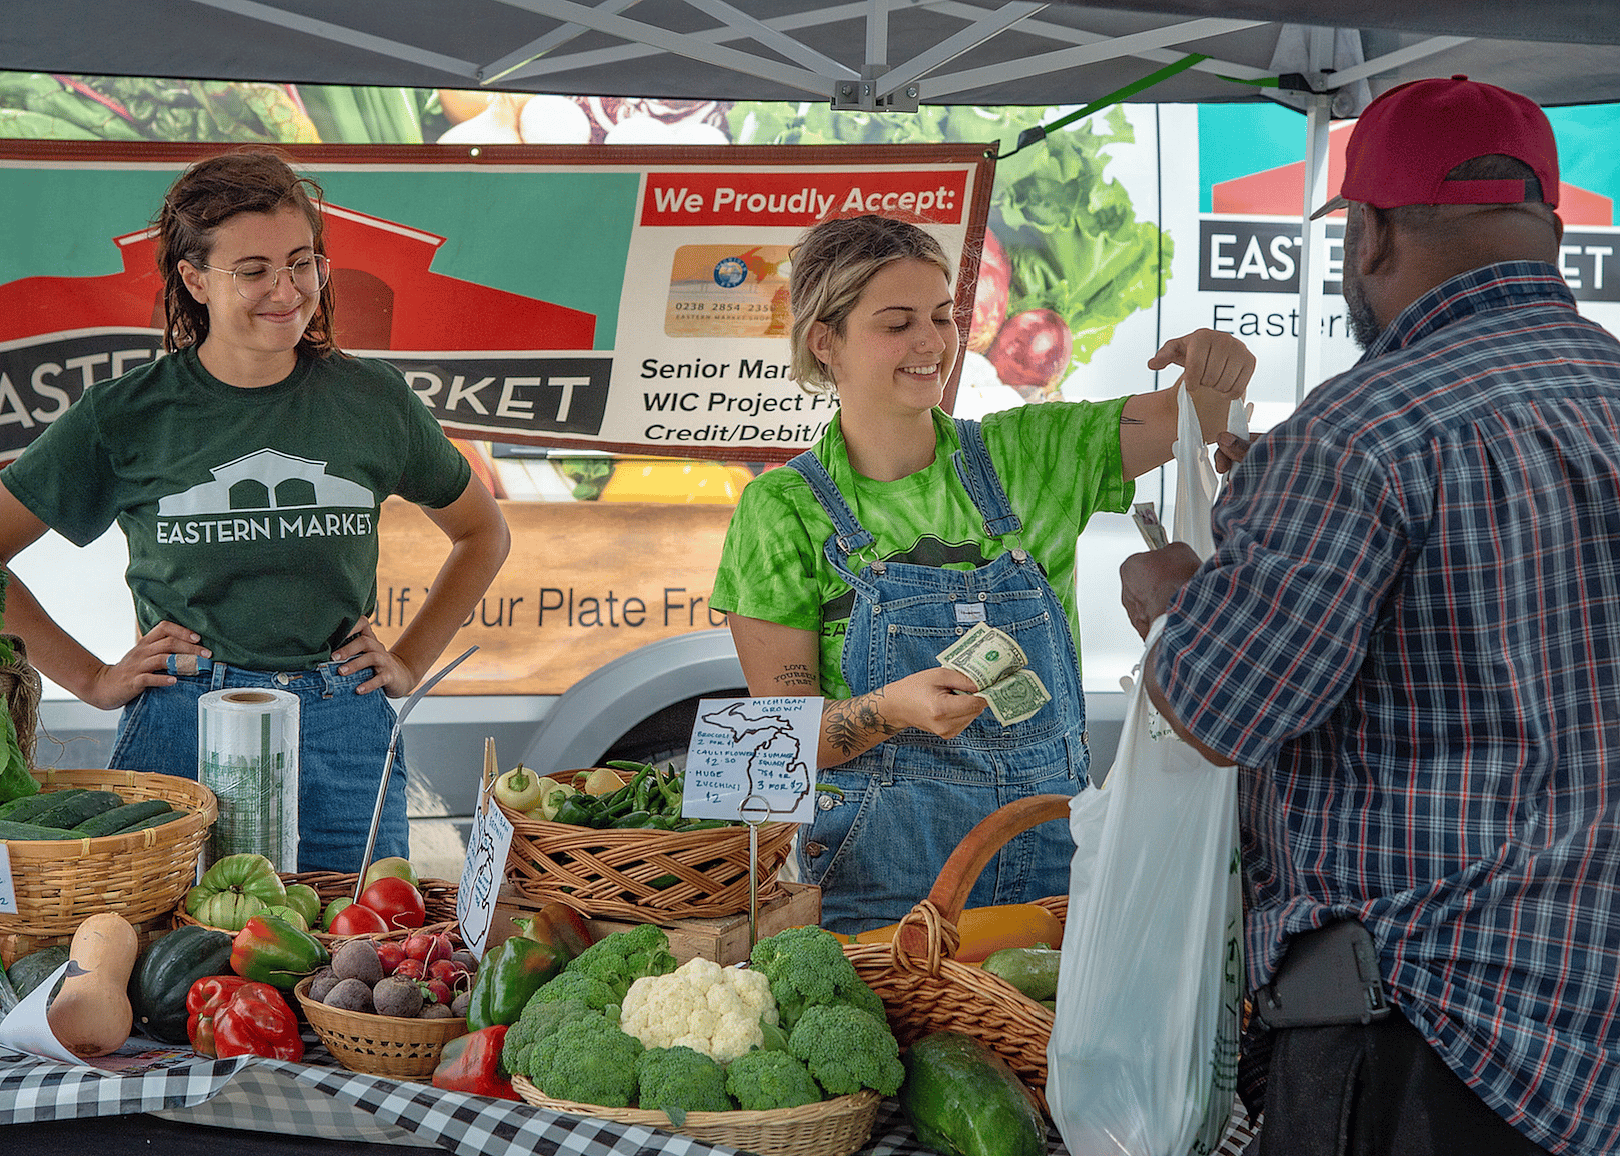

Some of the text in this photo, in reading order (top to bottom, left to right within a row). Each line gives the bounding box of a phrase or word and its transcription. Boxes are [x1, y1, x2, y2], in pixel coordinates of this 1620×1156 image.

[653, 186, 956, 220] We Proudly Accept:
[1210, 233, 1345, 282] EASE
[675, 302, 705, 311] 0238
[711, 303, 741, 312] 2854
[640, 358, 730, 379] Senior
[643, 392, 700, 412] WIC
[707, 392, 804, 417] Project
[156, 518, 271, 544] EASTERN
[538, 587, 647, 628] Plate
[784, 679, 812, 687] FIRST
[752, 698, 807, 707] MICHIGAN
[761, 705, 803, 713] GROWN
[695, 770, 724, 778] HUGE
[695, 780, 741, 791] ZUCCHINI
[757, 780, 804, 795] 3 FOR $2
[706, 791, 722, 804] $2
